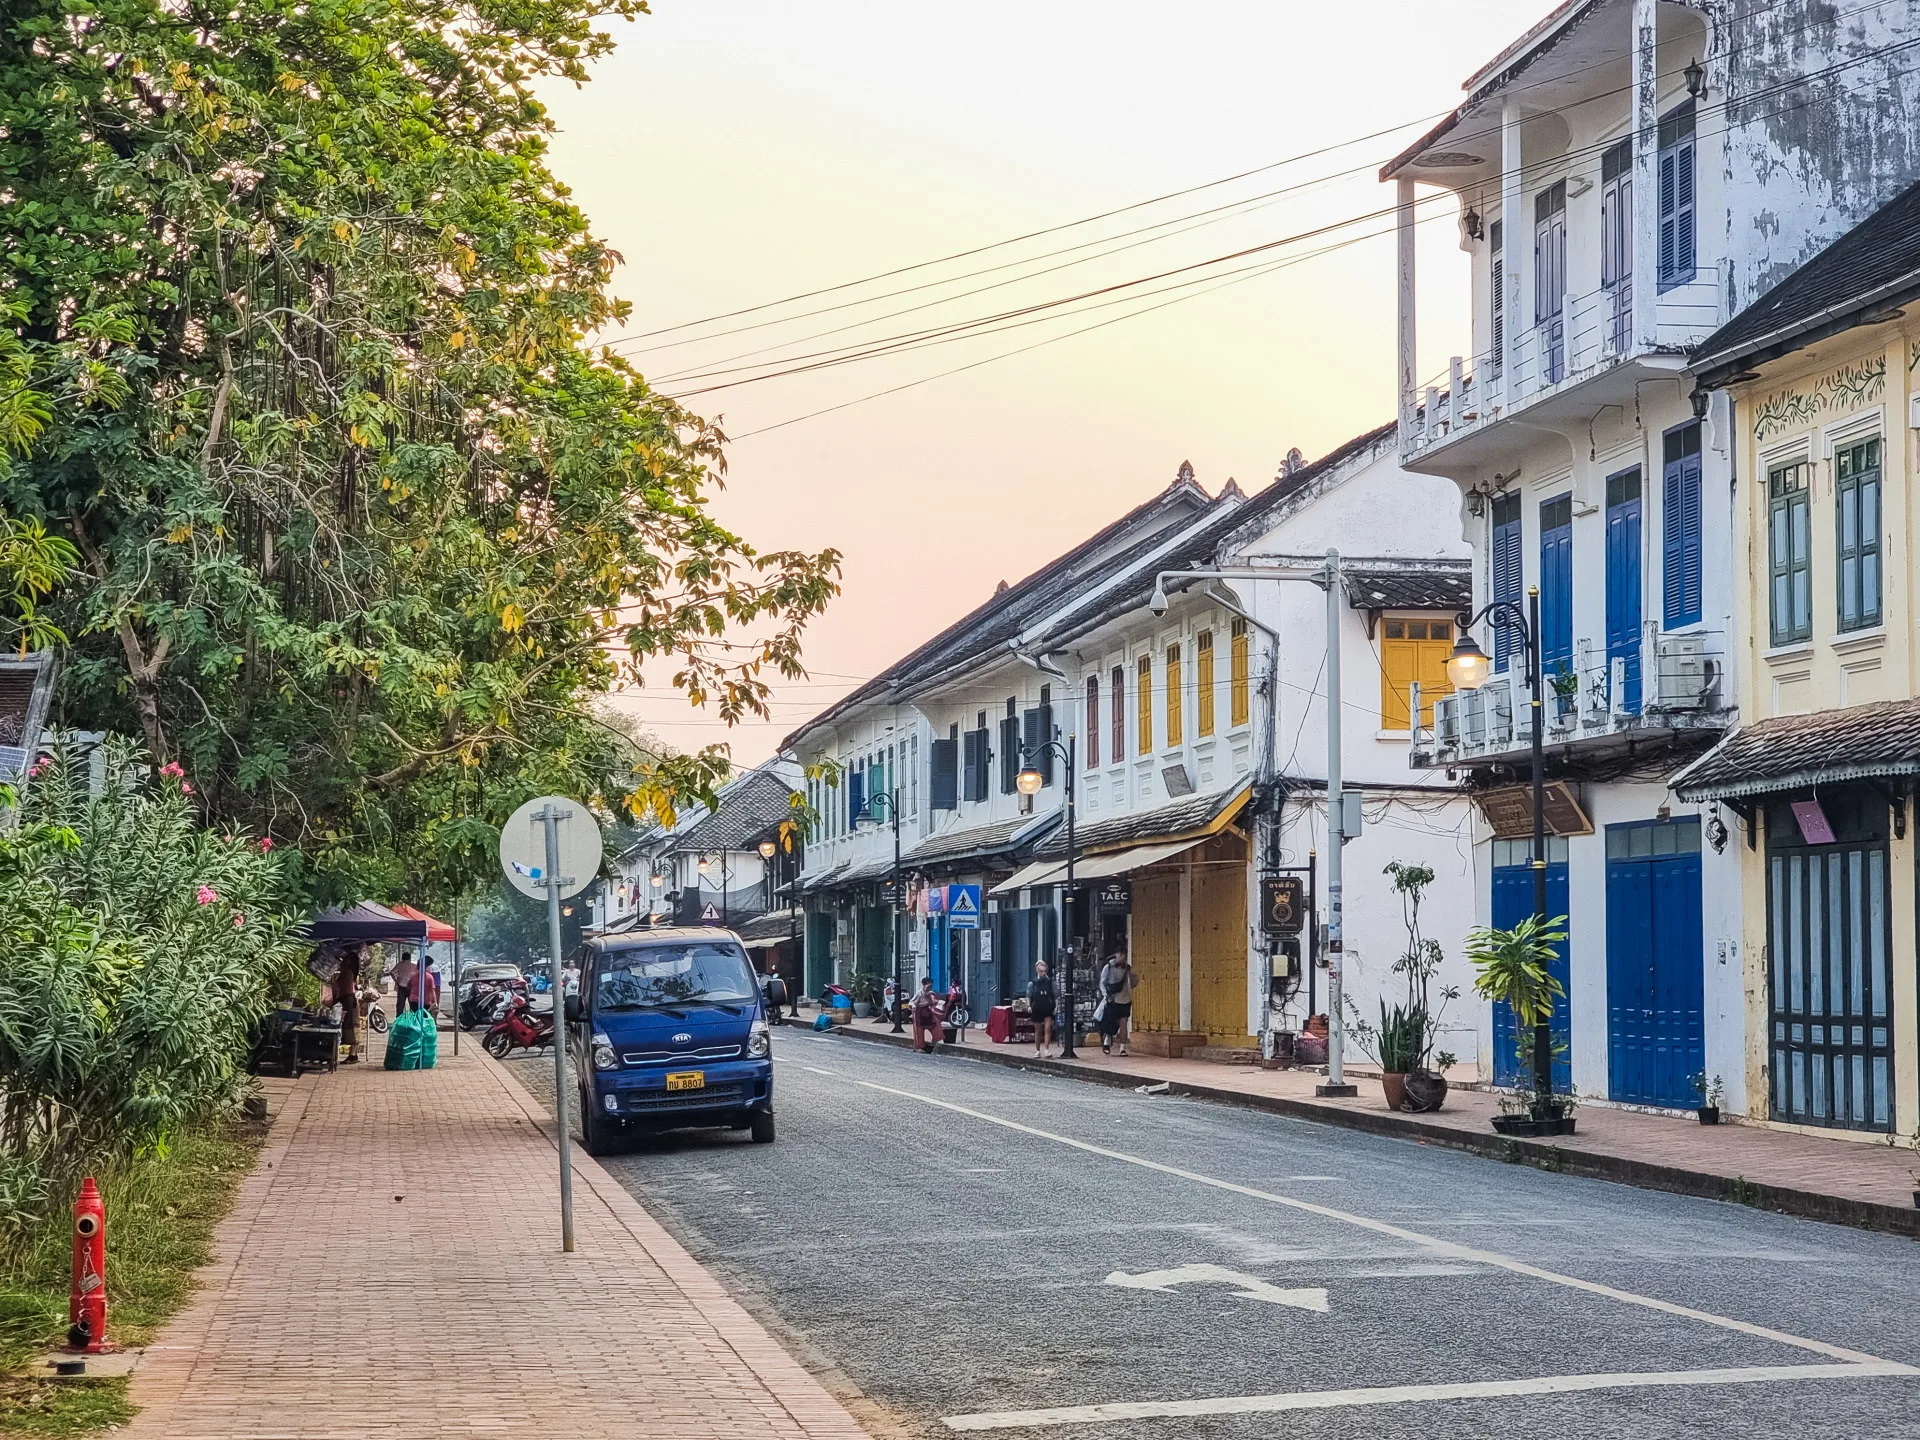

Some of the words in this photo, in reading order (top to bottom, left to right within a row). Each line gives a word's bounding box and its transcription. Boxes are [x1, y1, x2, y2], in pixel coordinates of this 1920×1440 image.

[1100, 892, 1128, 901] TAEC
[674, 1034, 690, 1043] KIA
[682, 1079, 703, 1089] 8807
